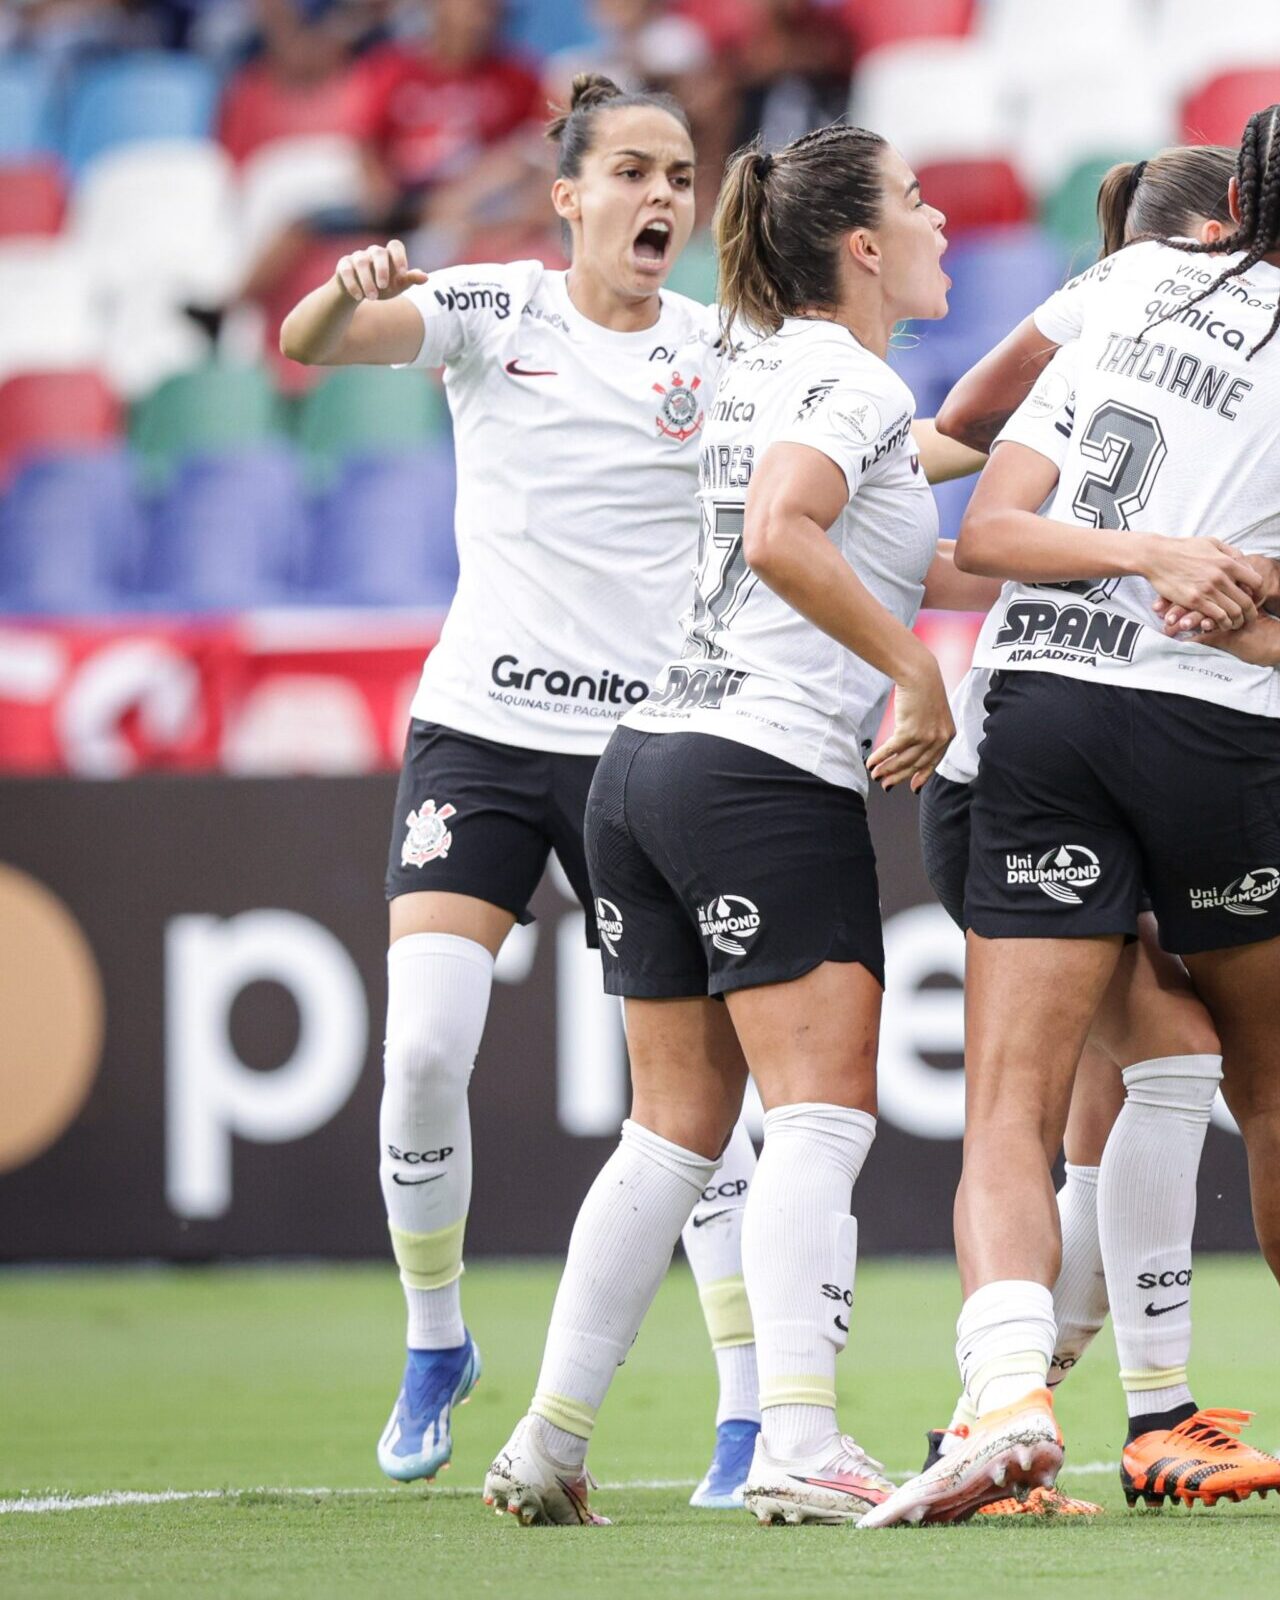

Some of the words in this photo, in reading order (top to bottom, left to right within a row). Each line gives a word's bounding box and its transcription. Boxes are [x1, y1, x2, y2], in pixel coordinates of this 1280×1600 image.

[451, 286, 511, 319] bmg
[1096, 331, 1254, 421] TARCIANE
[993, 599, 1144, 662] SPANI
[1007, 649, 1097, 667] ATACADISTA
[491, 655, 650, 705] Granito
[1006, 854, 1032, 870] Uni
[1007, 864, 1100, 884] DRUMMOND
[1189, 887, 1217, 900] Uni
[1190, 876, 1280, 909] DRUMMOND
[388, 1145, 453, 1164] SCCP
[697, 1179, 748, 1203] CCP
